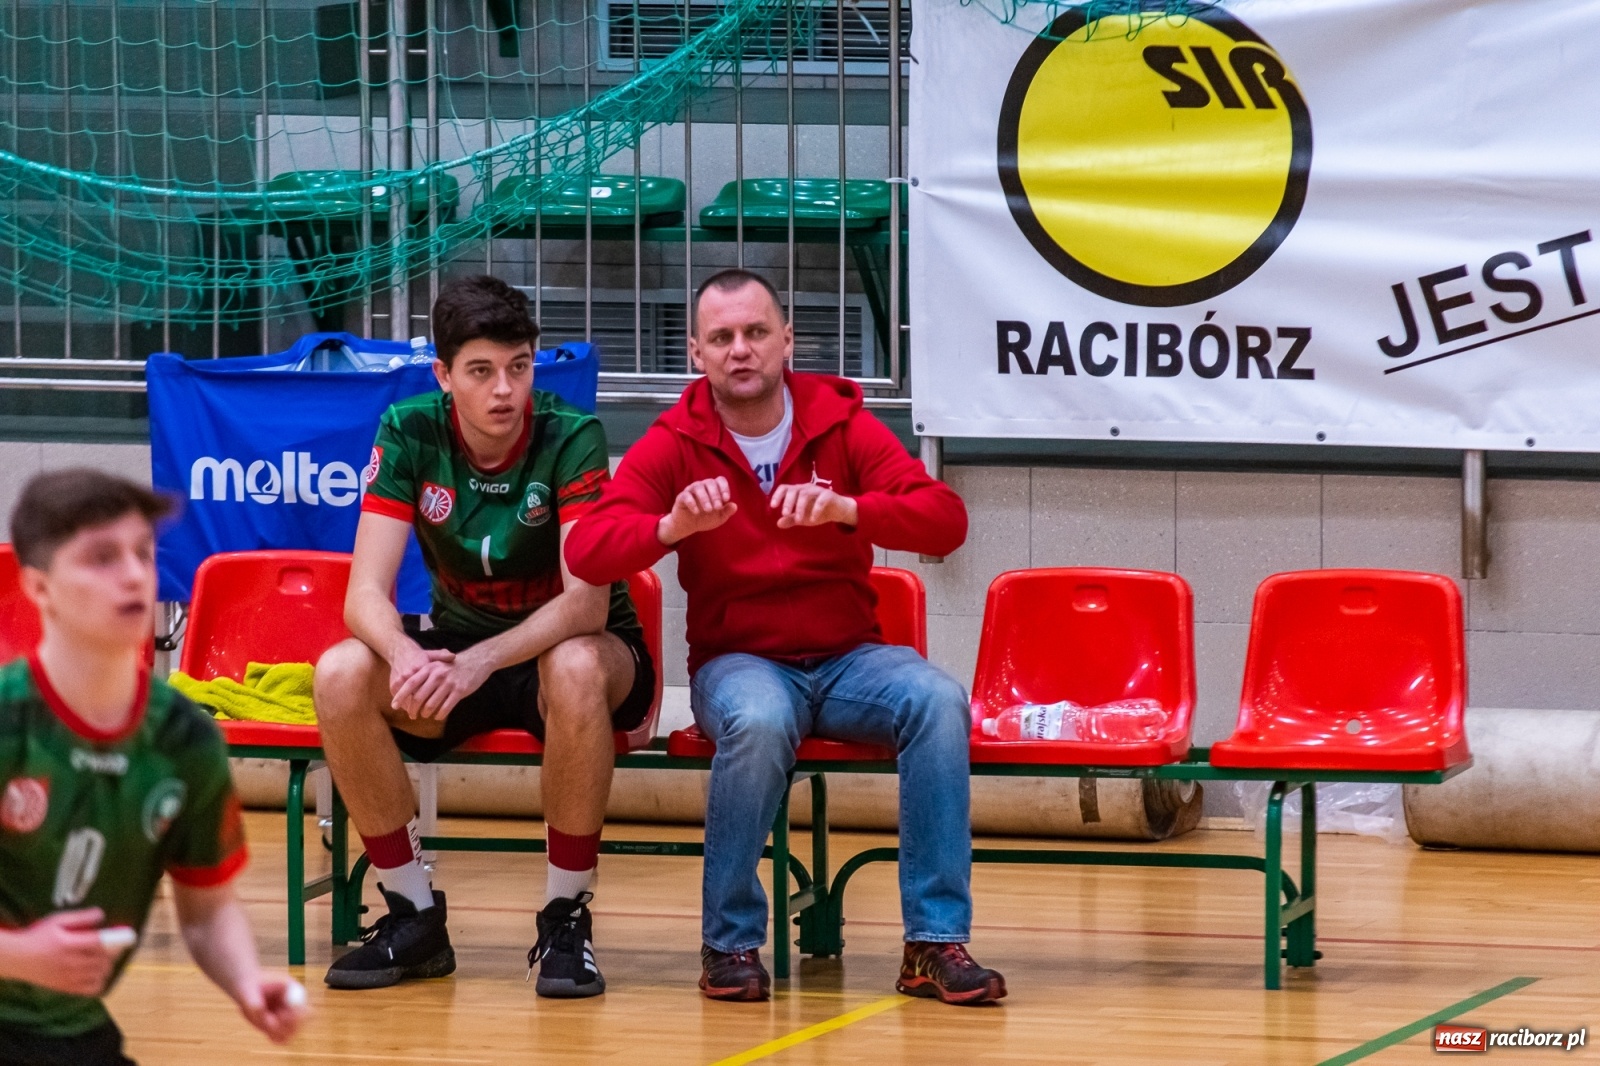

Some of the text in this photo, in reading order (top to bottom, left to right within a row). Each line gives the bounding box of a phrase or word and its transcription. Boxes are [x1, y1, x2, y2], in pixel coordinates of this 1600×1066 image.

[1142, 45, 1286, 109] SIR
[1377, 229, 1593, 358] JEST
[997, 311, 1315, 380] RACIBÓRZ
[481, 535, 493, 576] 1
[53, 828, 106, 907] 0
